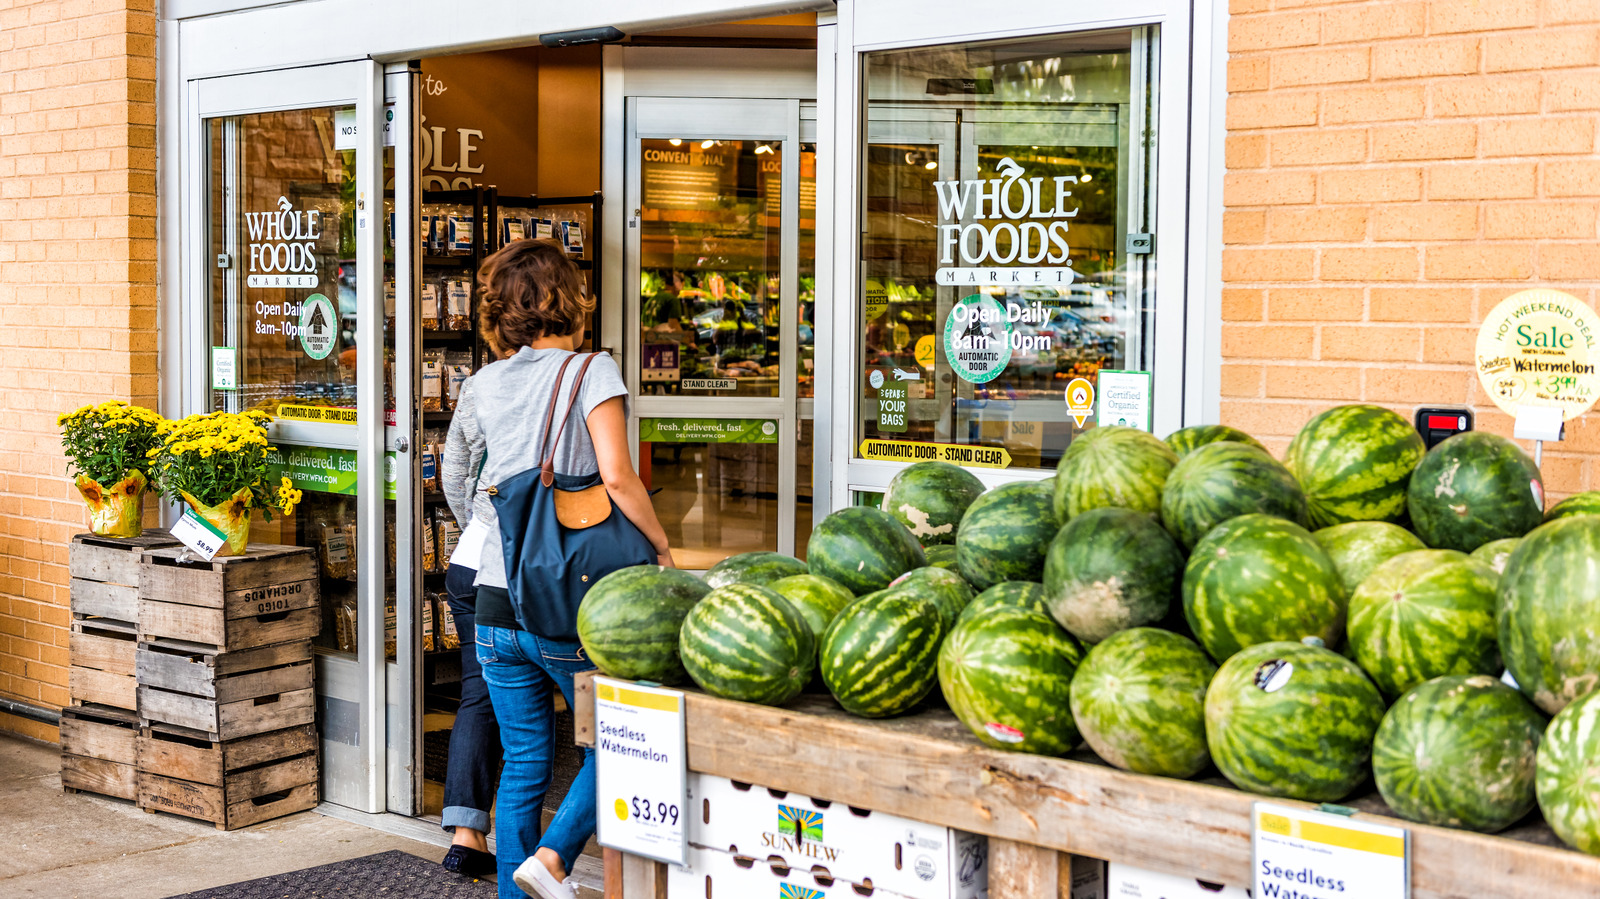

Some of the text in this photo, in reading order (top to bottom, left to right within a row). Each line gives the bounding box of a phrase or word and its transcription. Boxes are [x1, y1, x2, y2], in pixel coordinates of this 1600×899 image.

[426, 74, 448, 96] to
[342, 126, 352, 136] NO
[932, 166, 1079, 220] WHOLE
[245, 203, 320, 241] WHOLE
[940, 220, 1070, 264] FOODS
[250, 242, 316, 272] FOODS
[252, 276, 313, 286] MARKET
[946, 270, 1064, 282] MARKET
[255, 300, 307, 321] Open Daily
[952, 301, 1052, 329] Open Daily
[1512, 302, 1574, 320] WEEKEND
[1495, 317, 1512, 342] HOT
[1516, 324, 1574, 348] Sale
[1574, 318, 1596, 350] DEAL
[306, 336, 330, 344] AUTOMATIC
[958, 352, 999, 361] AUTOMATIC
[1513, 357, 1595, 374] Watermelon
[968, 362, 988, 371] DOOR
[684, 380, 705, 388] STAND
[884, 388, 900, 398] GRAB
[1107, 390, 1140, 400] Certified
[281, 406, 307, 418] AUTOMATIC
[308, 408, 321, 419] DOOR
[325, 410, 341, 421] STAND
[880, 400, 906, 412] YOUR
[1108, 400, 1139, 410] Organic
[657, 422, 744, 432] fresh. delivered. fast.
[881, 413, 904, 426] BAGS
[288, 452, 336, 470] delivered.
[867, 442, 912, 458] AUTOMATIC
[914, 445, 937, 459] DOOR
[945, 448, 972, 462] STAND
[974, 450, 1002, 464] CLEAR
[244, 584, 302, 602] ORCHARDS
[258, 599, 290, 613] TOIGO
[600, 720, 646, 742] Seedless
[600, 738, 668, 763] Watermelon
[632, 794, 679, 826] $3.99
[760, 830, 840, 862] SUNVIEW
[1262, 860, 1344, 892] Seedless
